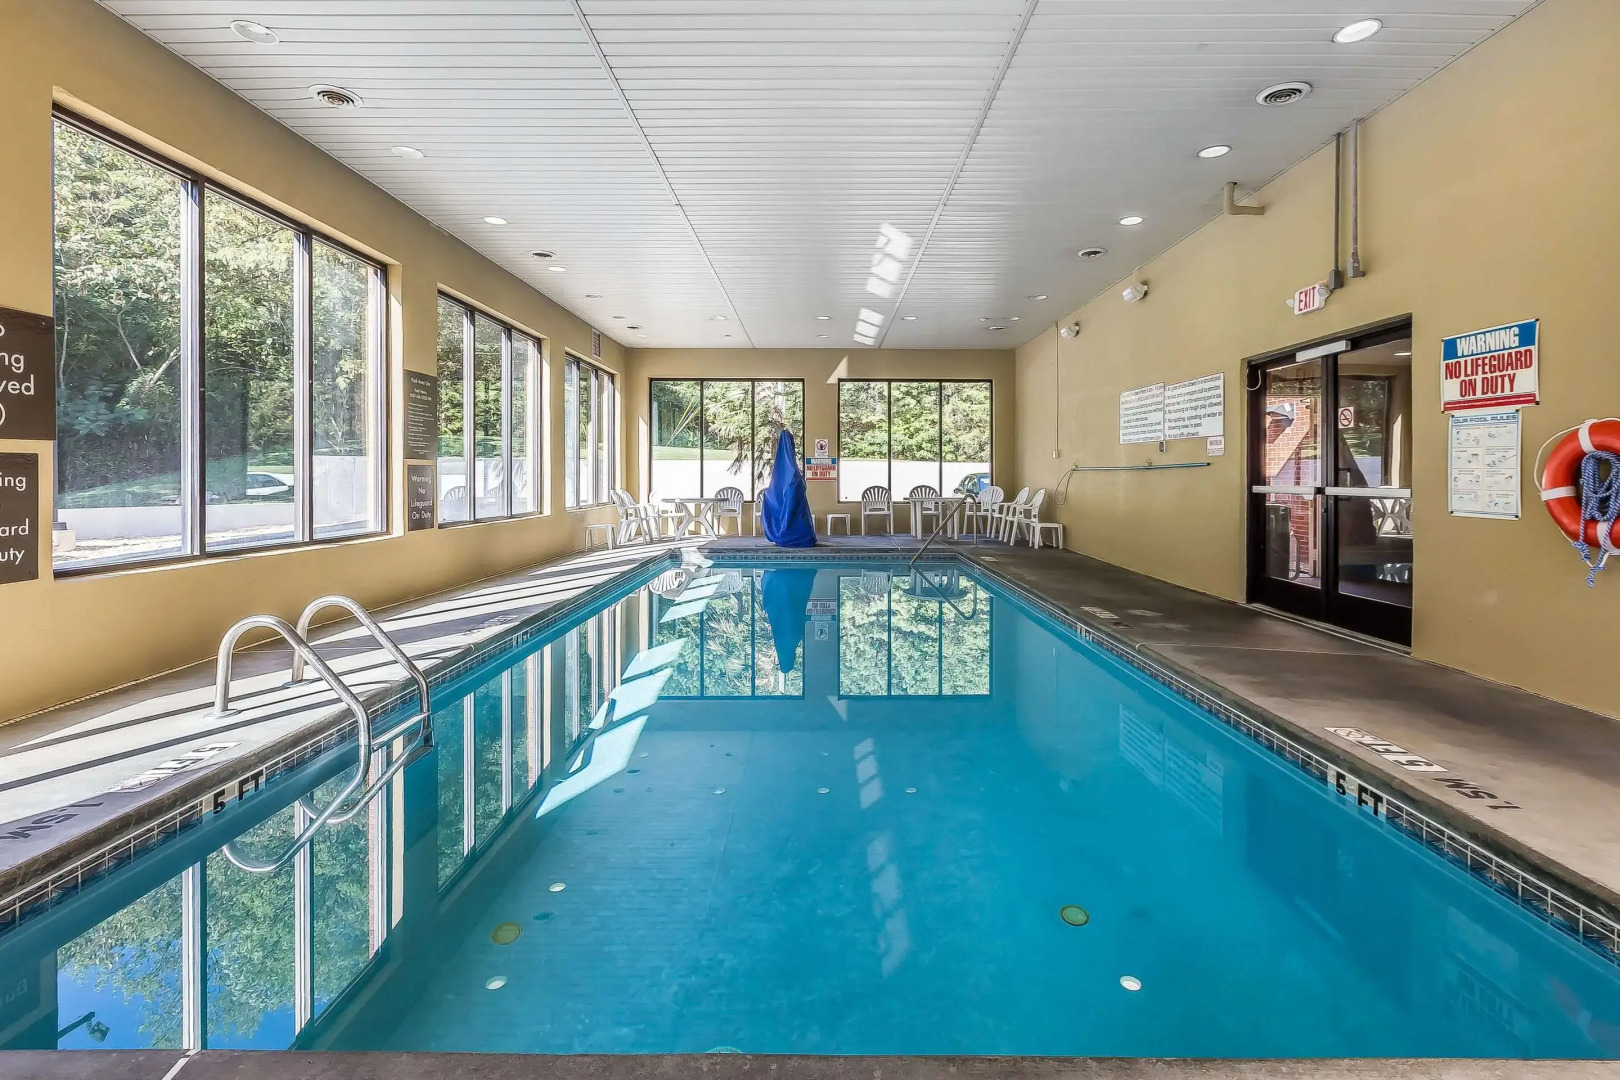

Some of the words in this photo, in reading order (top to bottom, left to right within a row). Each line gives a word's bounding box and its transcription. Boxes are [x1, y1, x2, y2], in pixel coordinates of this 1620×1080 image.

[1299, 286, 1316, 312] EXIT
[1456, 327, 1519, 357] WARNING
[1445, 360, 1461, 380] NO
[1464, 349, 1533, 377] LIFEGUARD
[1460, 378, 1476, 398] ON
[1481, 373, 1516, 396] DUTY
[411, 474, 431, 484] Warning
[418, 486, 426, 495] No
[411, 498, 432, 509] Lifeguard
[412, 511, 420, 520] On
[421, 510, 431, 520] Duty
[0, 518, 29, 537] ard
[213, 788, 226, 814] 5
[239, 769, 263, 801] FT
[1336, 771, 1346, 796] 5
[1358, 783, 1383, 817] FT
